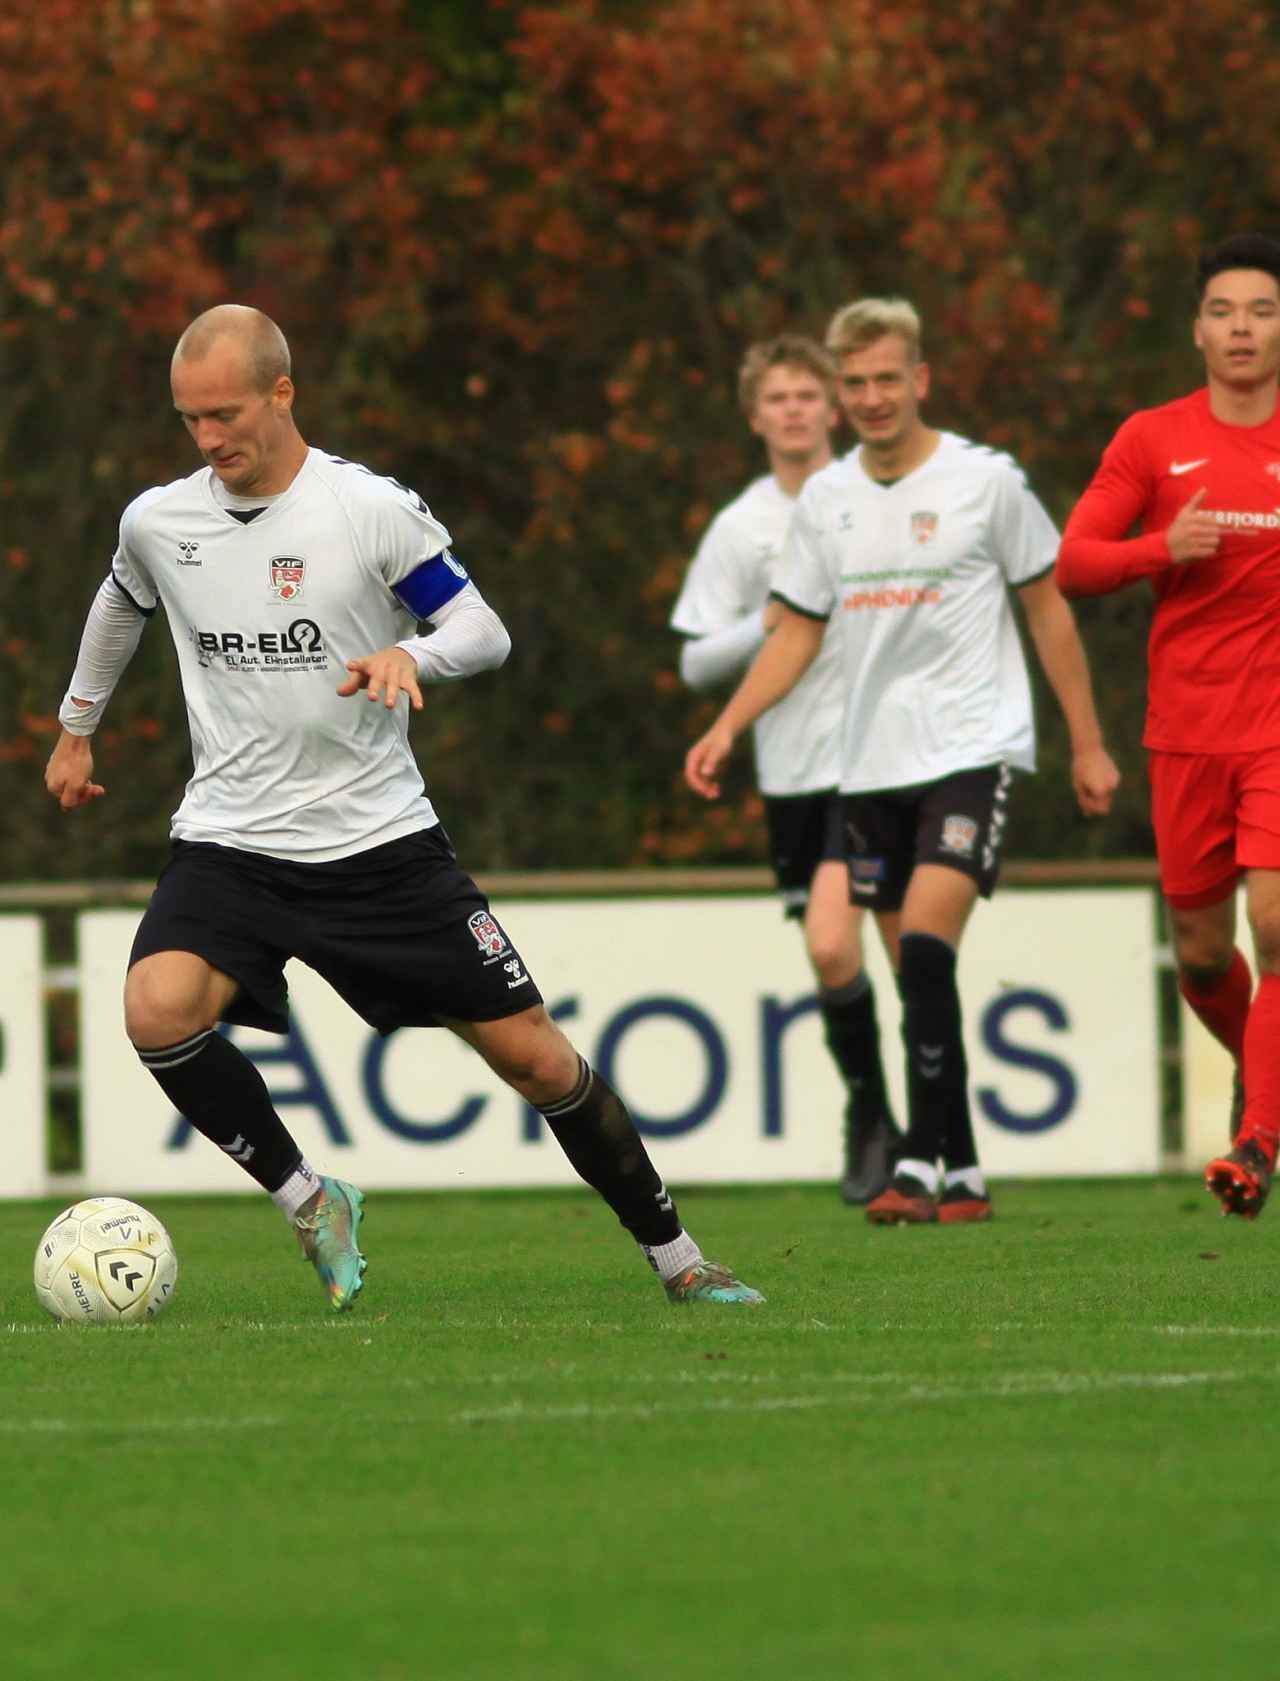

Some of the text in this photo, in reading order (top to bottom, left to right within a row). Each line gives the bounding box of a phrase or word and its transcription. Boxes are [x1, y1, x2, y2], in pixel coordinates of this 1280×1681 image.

[1198, 511, 1278, 529] RFJORD
[274, 560, 302, 568] VIF
[166, 985, 1079, 1152] Acons
[100, 1214, 141, 1234] hummel
[119, 1226, 159, 1246] VIF
[69, 1271, 94, 1314] HERRE
